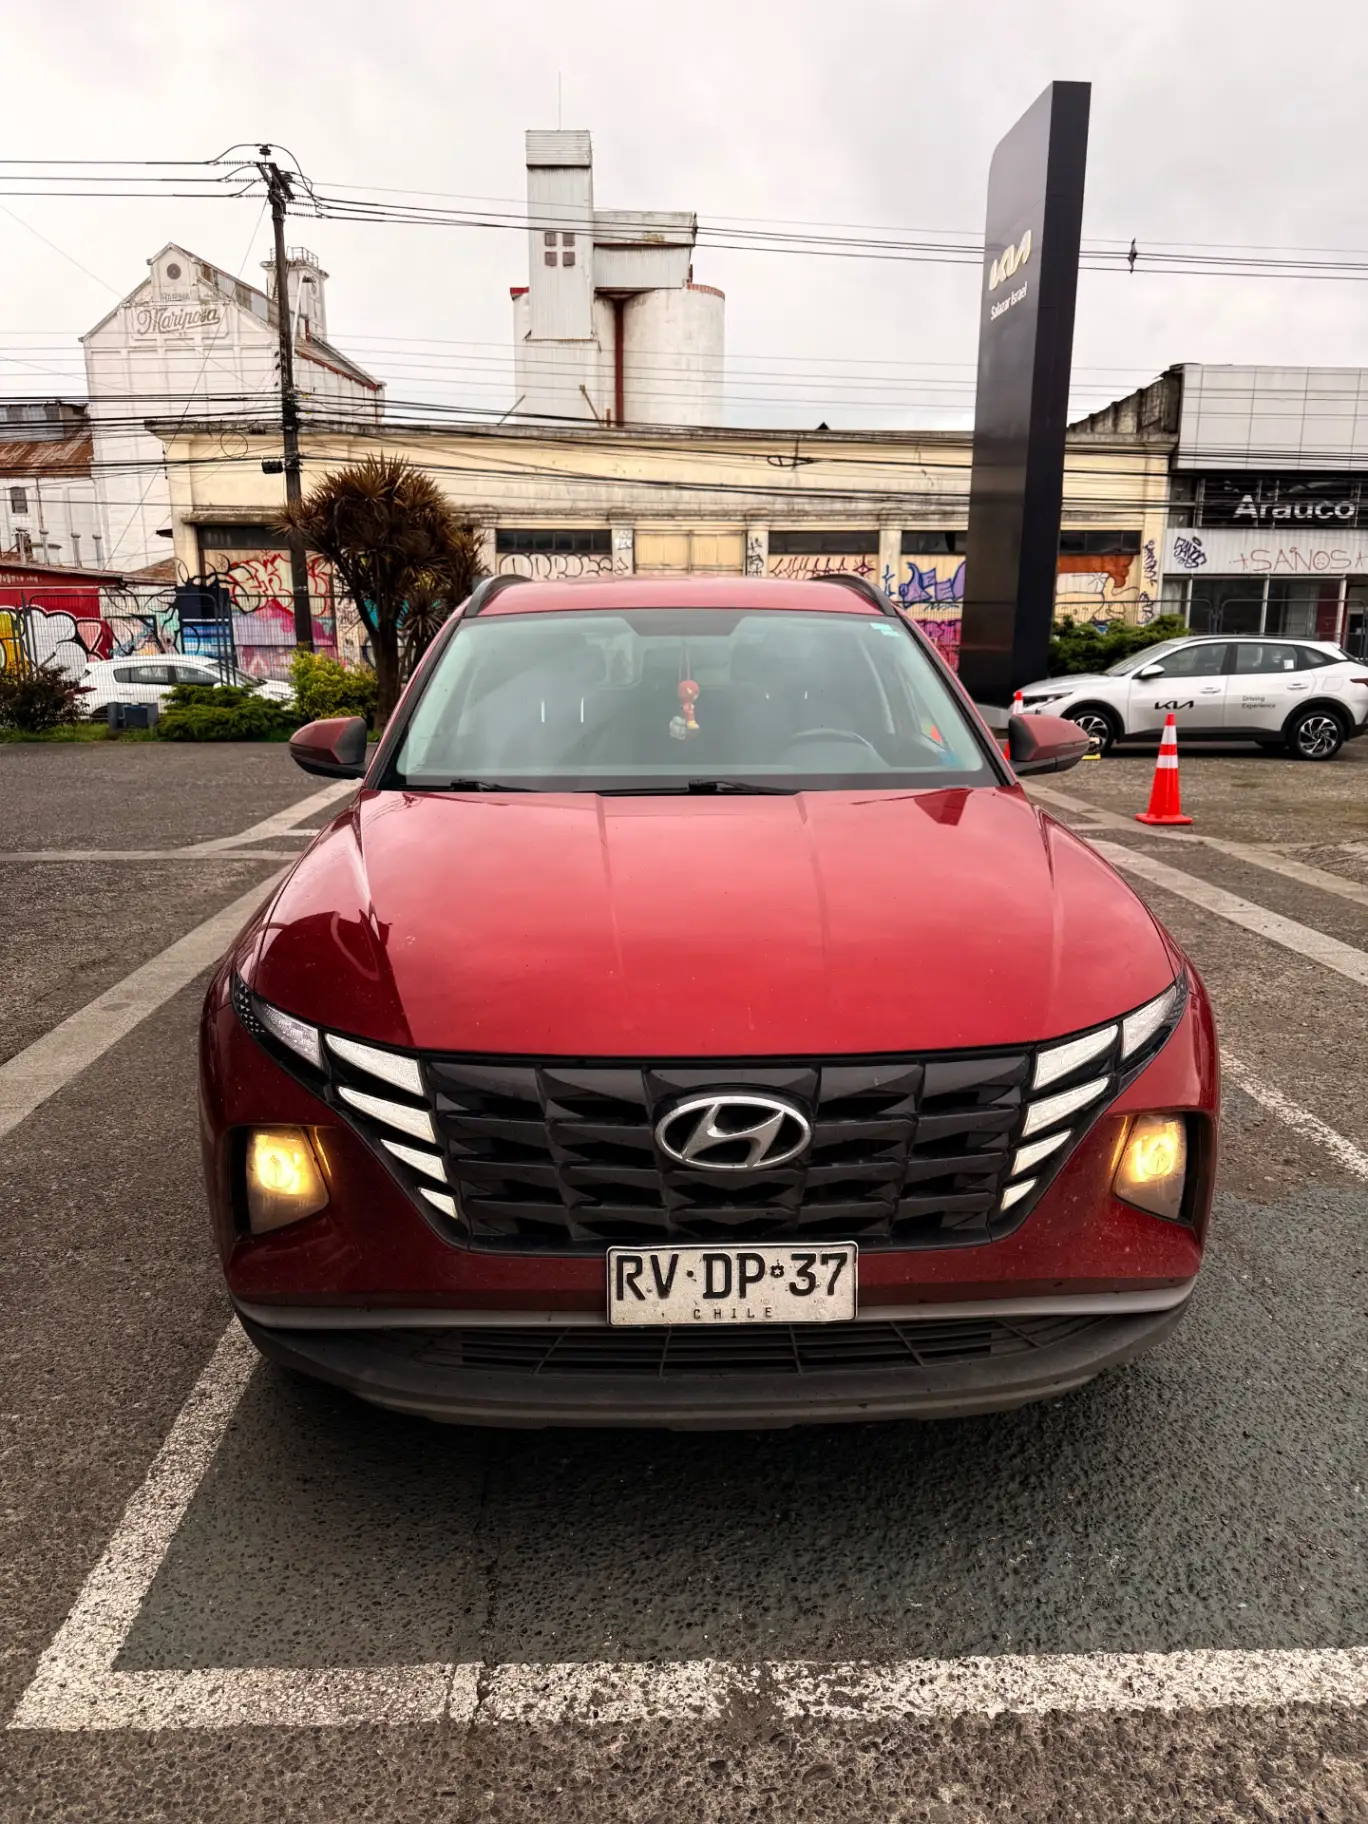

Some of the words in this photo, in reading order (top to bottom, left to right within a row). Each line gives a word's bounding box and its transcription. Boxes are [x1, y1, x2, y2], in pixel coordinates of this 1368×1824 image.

[137, 307, 220, 335] Mariposa
[1233, 494, 1356, 519] Arauco
[1154, 700, 1194, 710] KIA
[1242, 695, 1265, 703] Driving
[1242, 702, 1276, 710] Experience
[693, 1306, 773, 1320] CHILE
